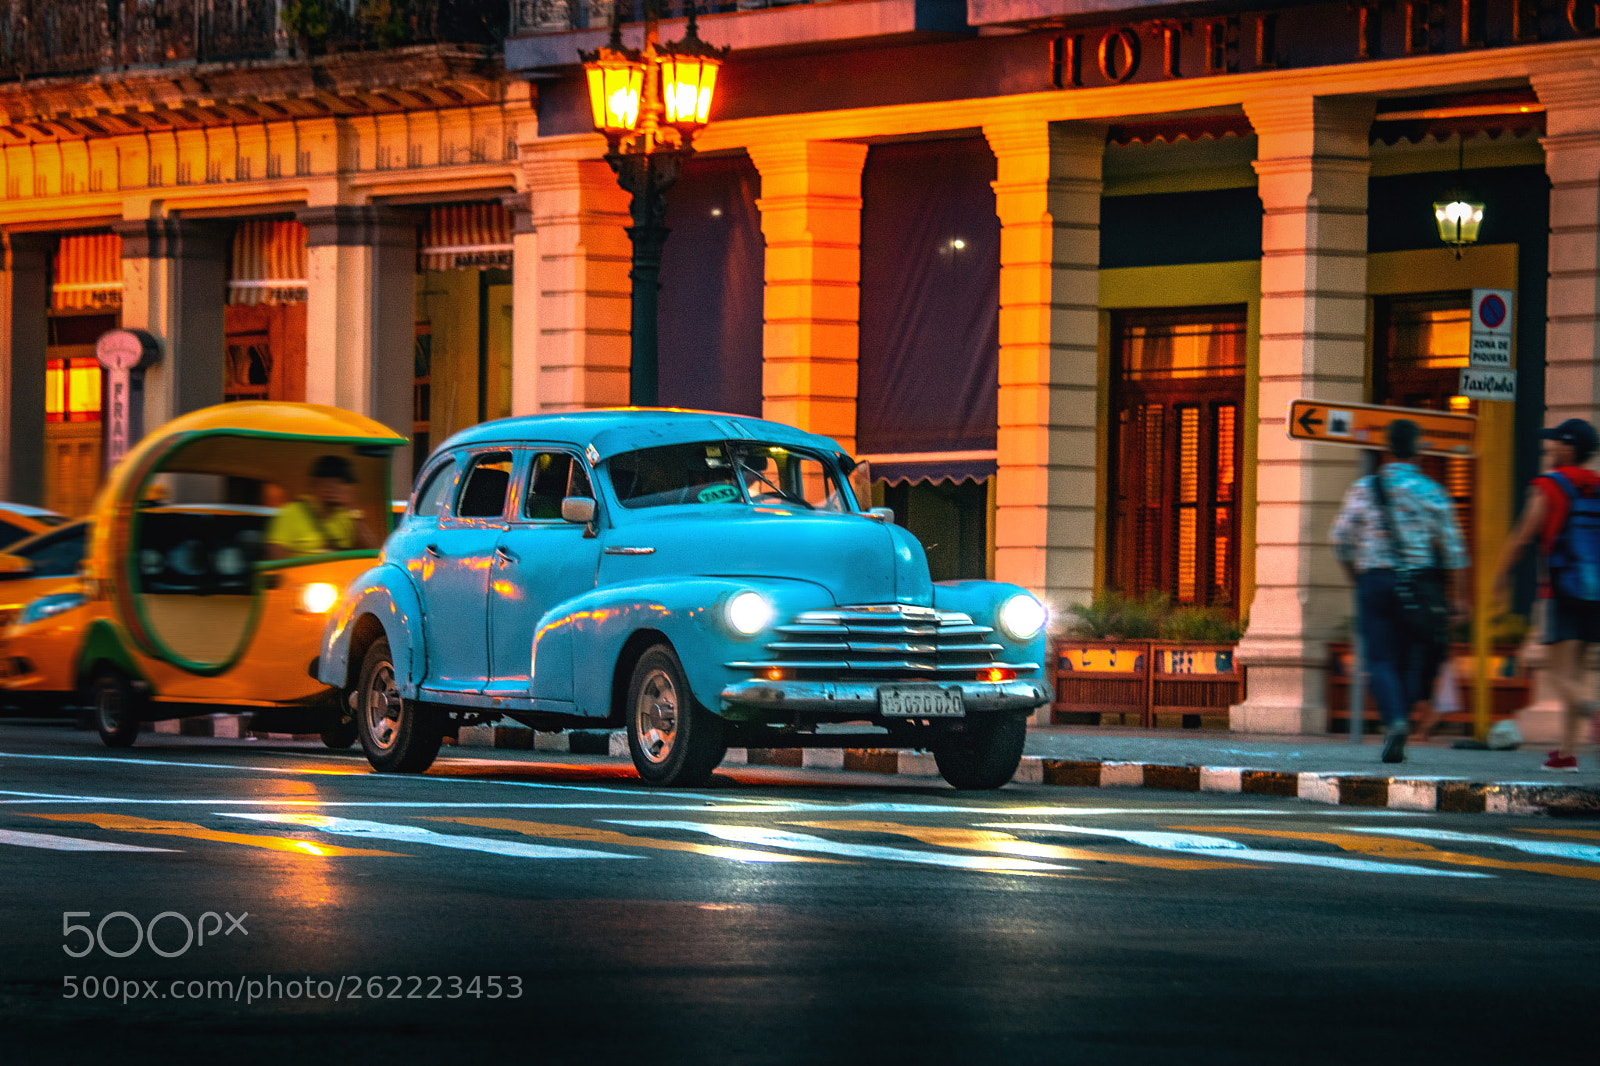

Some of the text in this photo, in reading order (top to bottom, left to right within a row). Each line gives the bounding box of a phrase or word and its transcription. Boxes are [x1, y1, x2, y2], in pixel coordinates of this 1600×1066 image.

[1048, 14, 1279, 89] HOTEL
[1474, 339, 1508, 350] ZONA DE
[1473, 352, 1508, 362] PIQUERA
